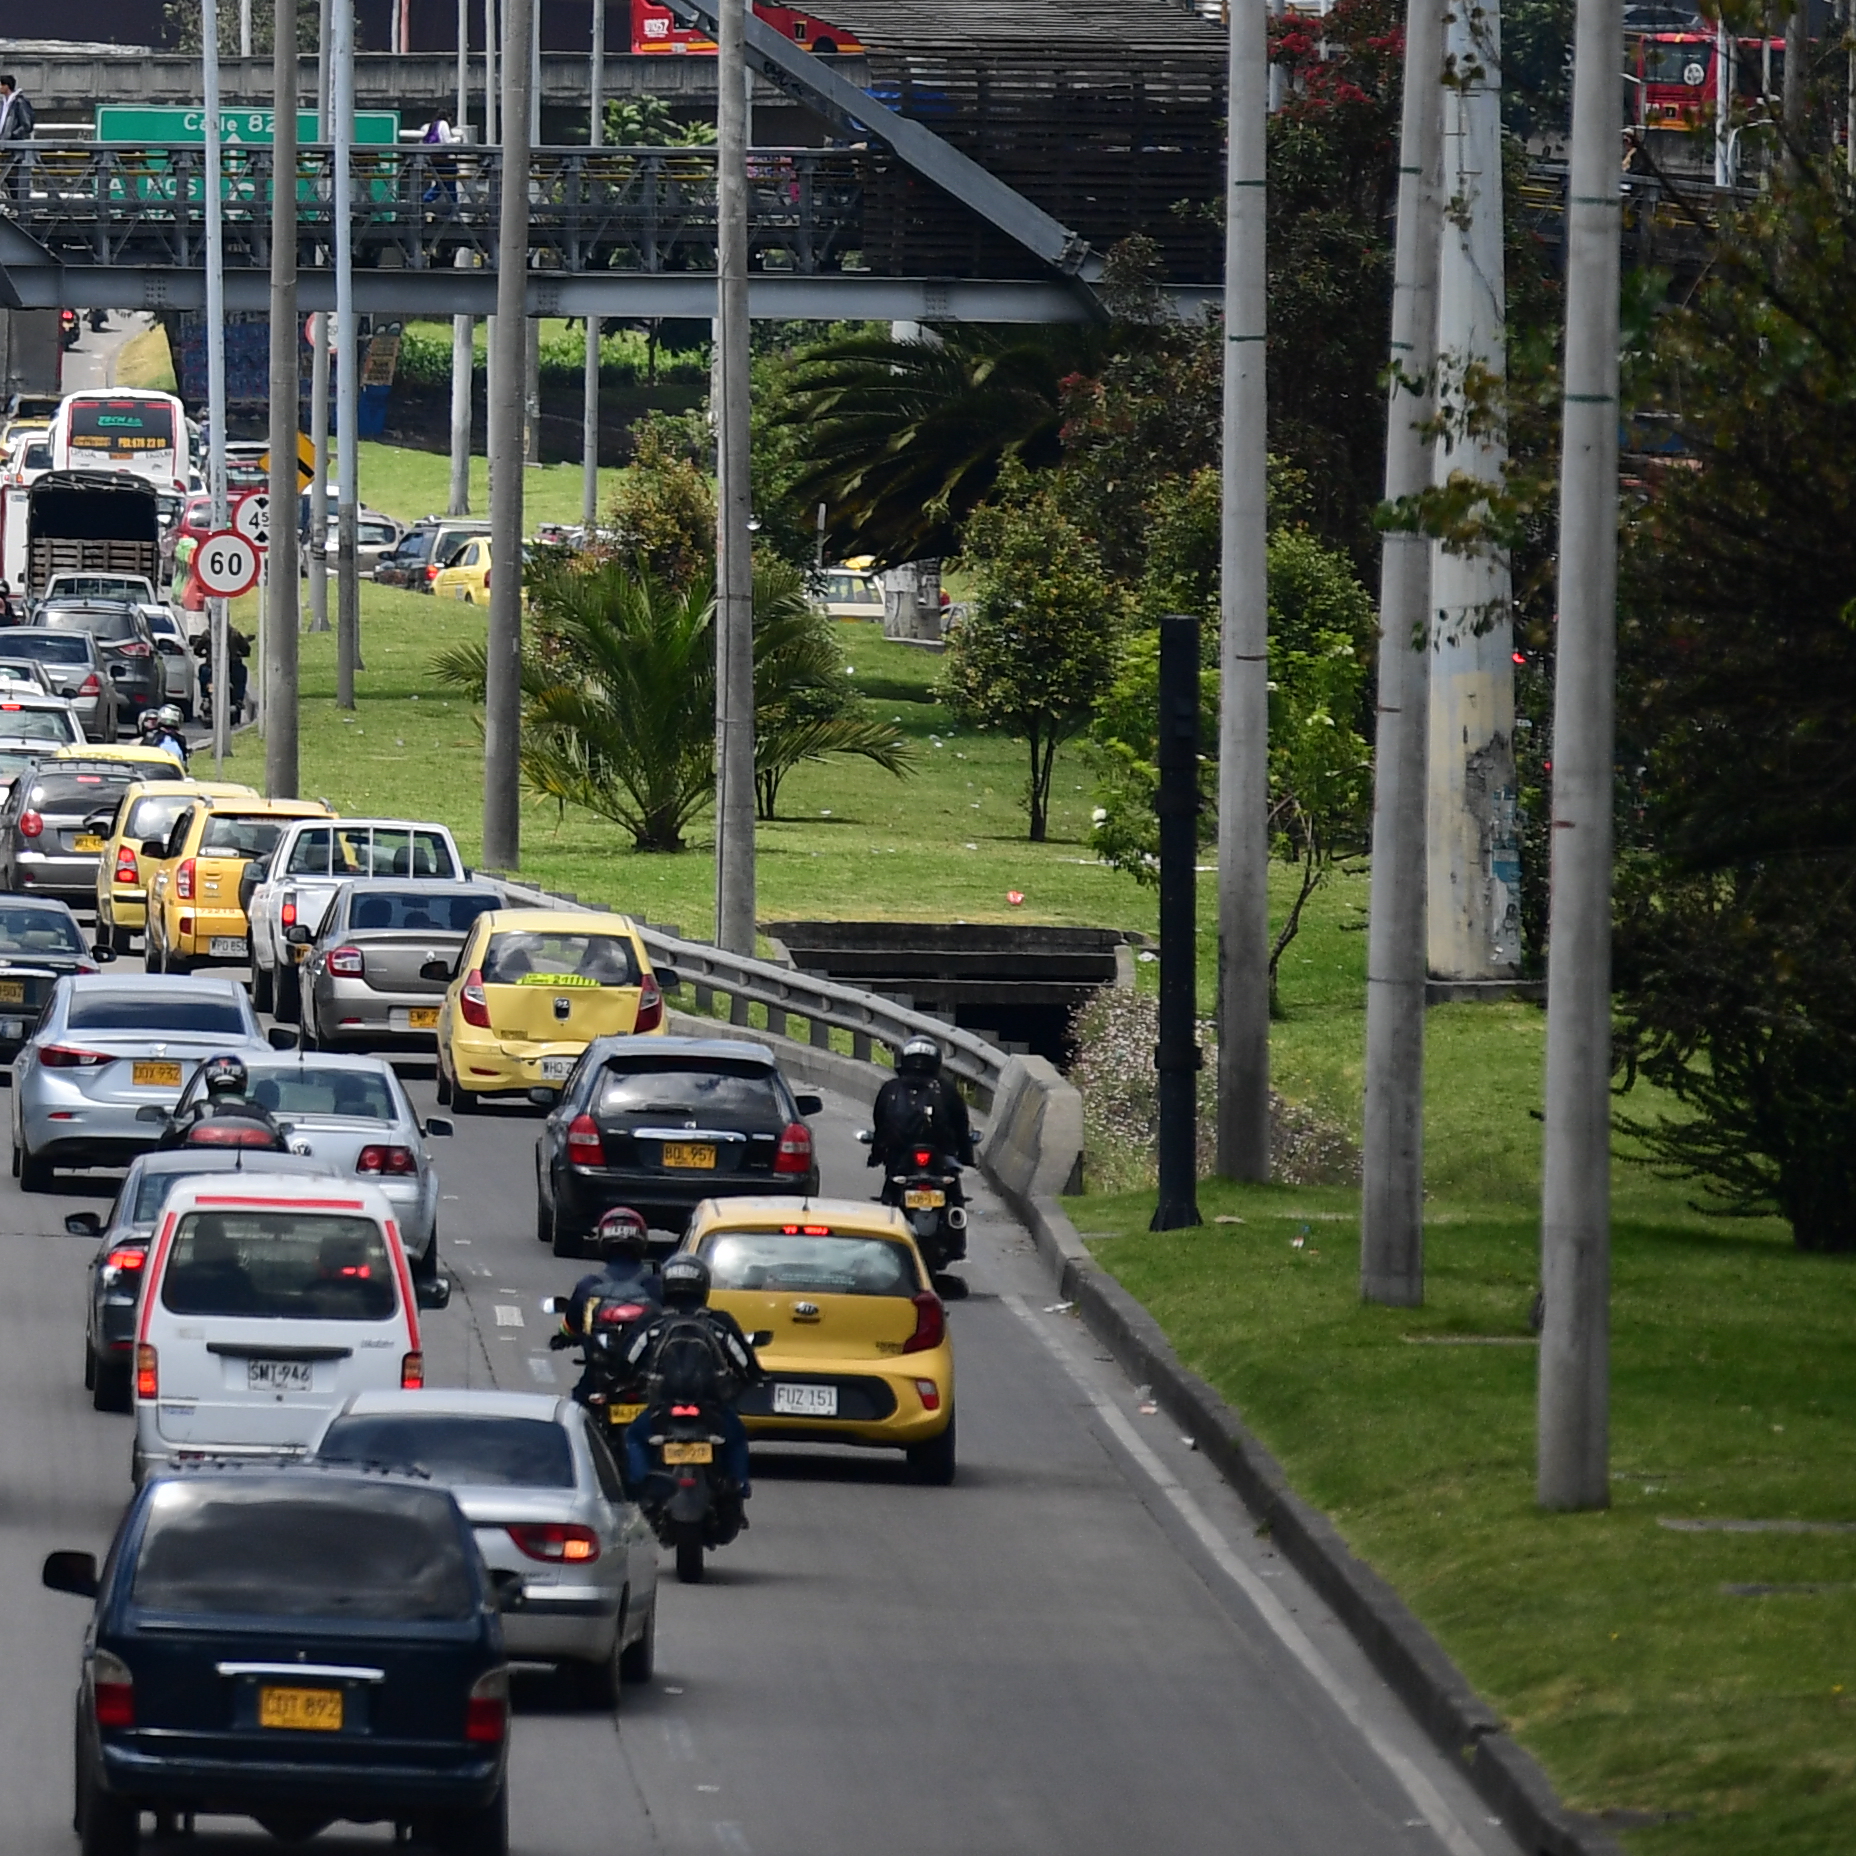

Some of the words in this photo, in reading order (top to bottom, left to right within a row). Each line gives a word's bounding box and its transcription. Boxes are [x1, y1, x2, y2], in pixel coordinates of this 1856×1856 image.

[248, 512, 260, 530] 4
[210, 552, 242, 575] 60
[778, 1387, 806, 1406] FUZ
[810, 1388, 836, 1408] 151
